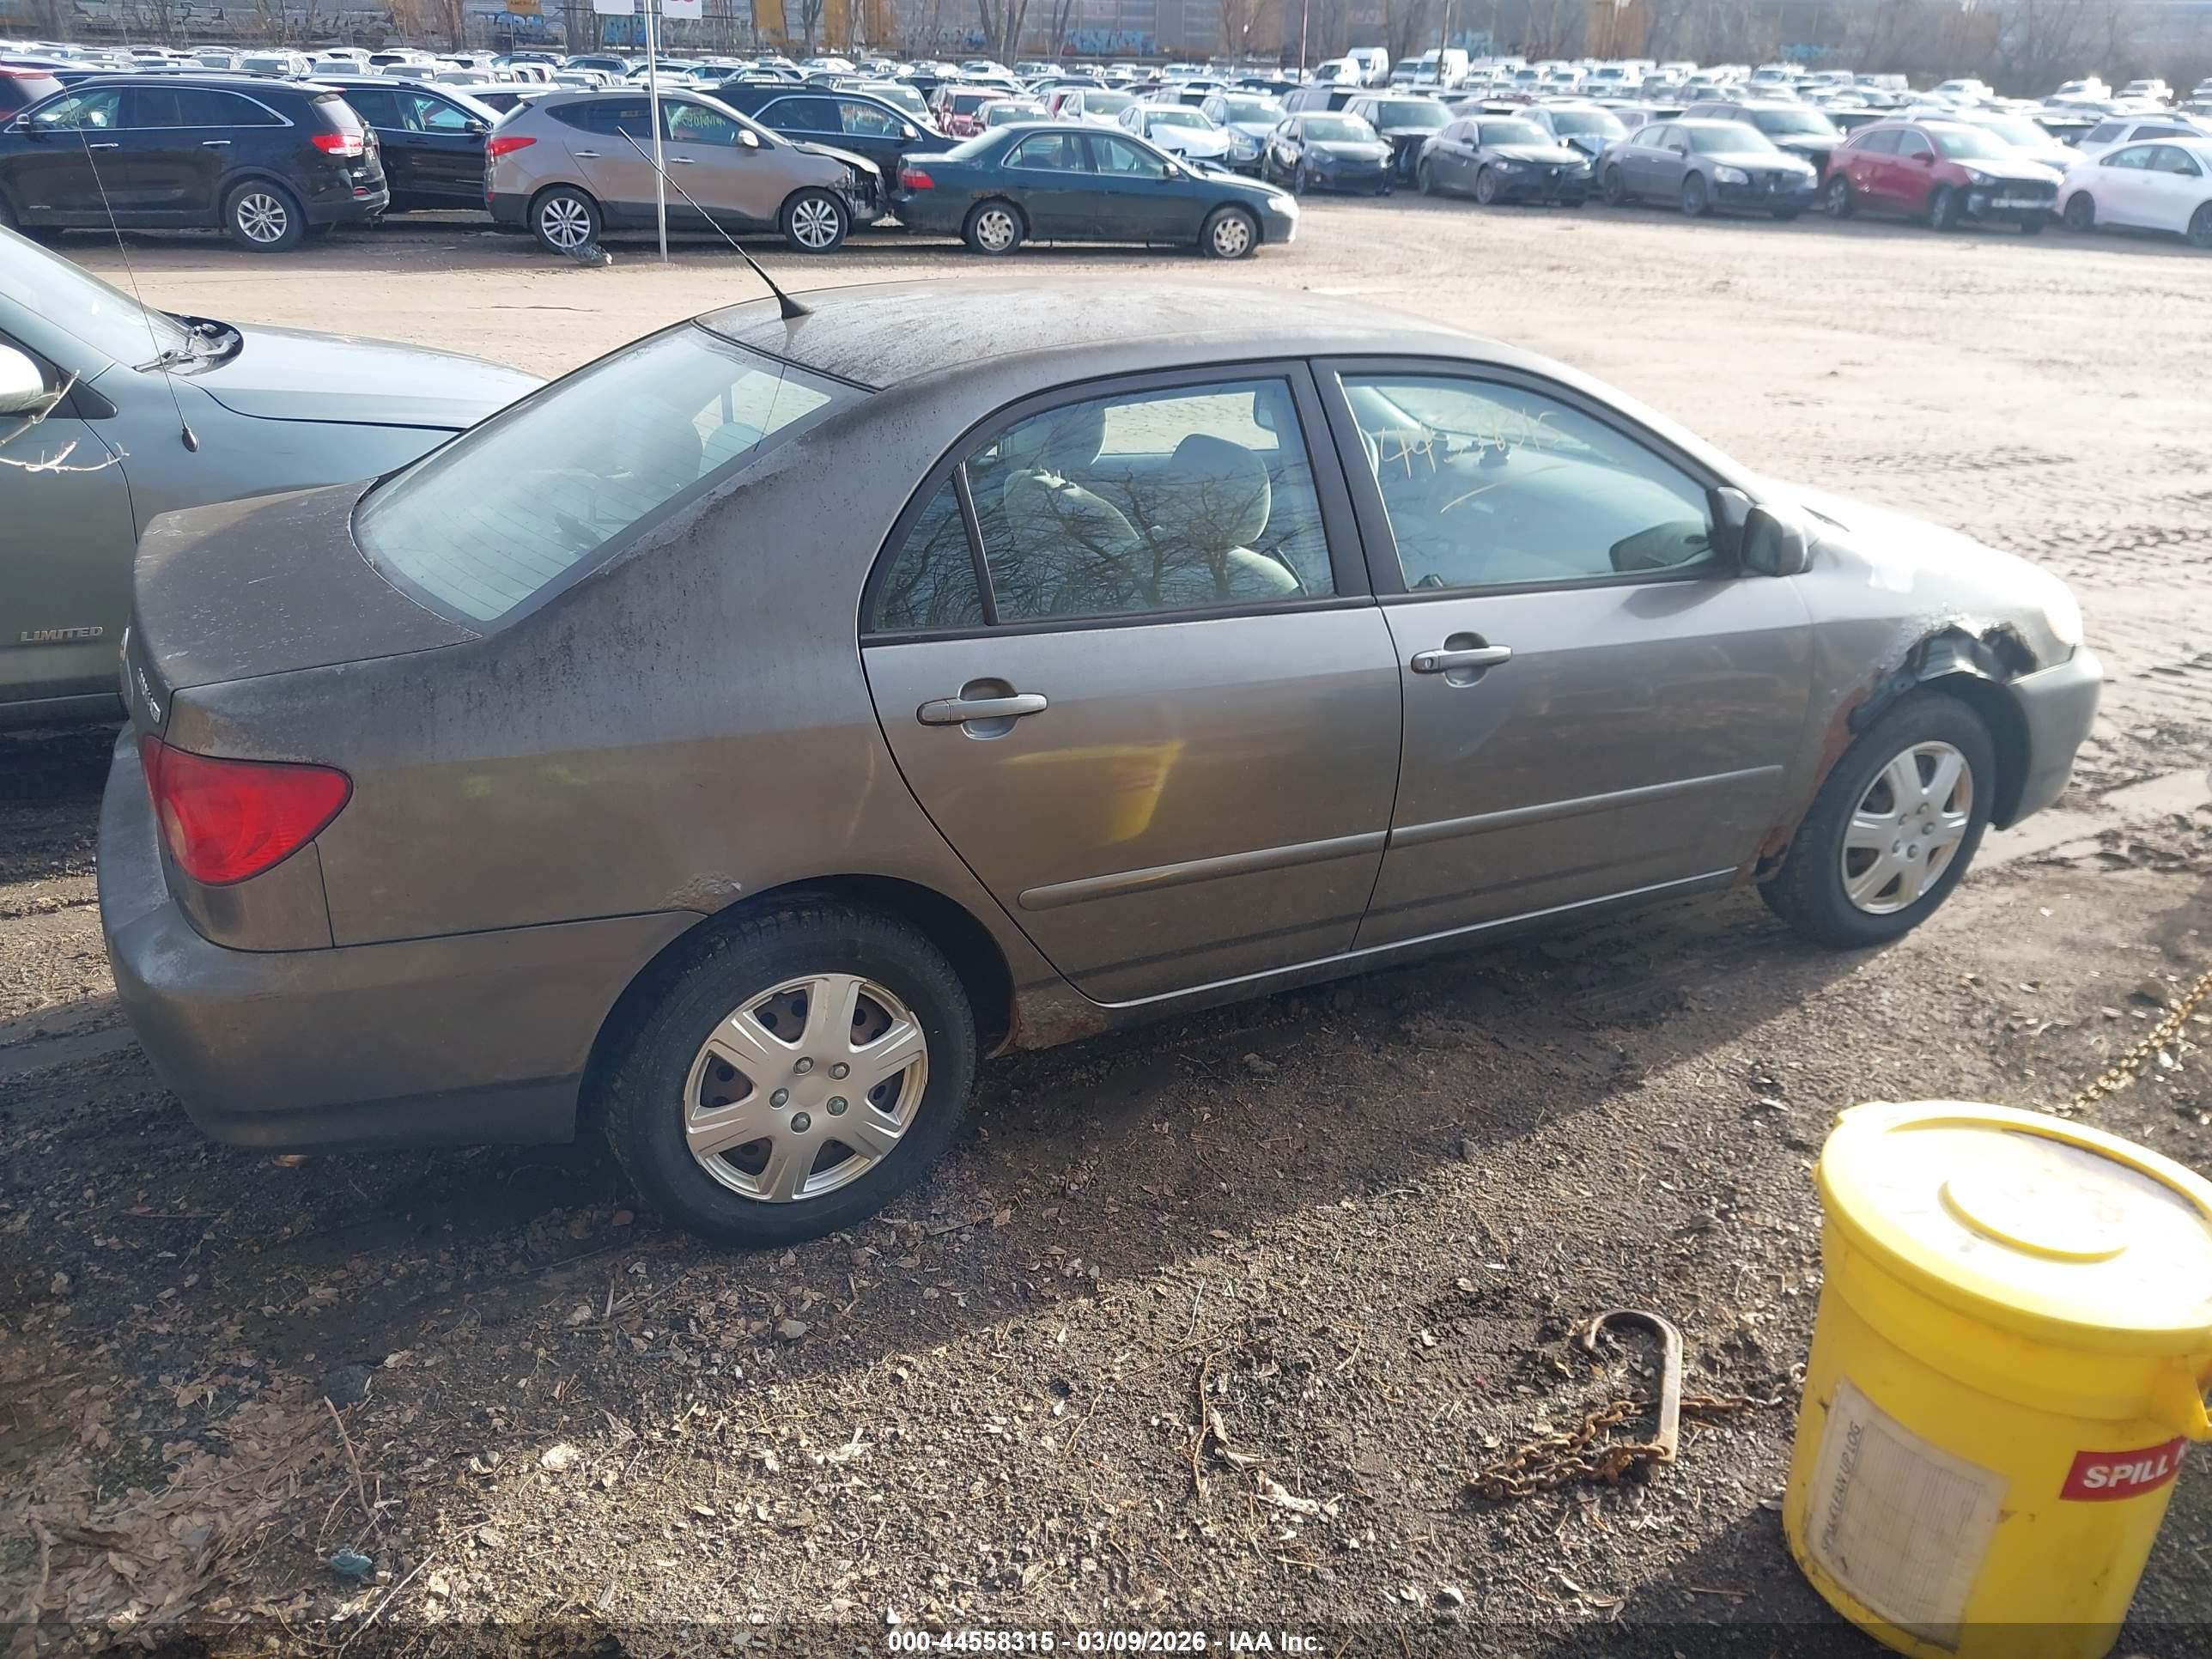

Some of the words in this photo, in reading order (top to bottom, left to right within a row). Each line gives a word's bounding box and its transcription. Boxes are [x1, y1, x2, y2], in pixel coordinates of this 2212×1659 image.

[21, 626, 103, 642] LIMITED
[1828, 1472, 1849, 1520] CLEAN
[1839, 1451, 1851, 1474] UP
[1845, 1420, 1861, 1454] LOG
[2083, 1455, 2168, 1489] SPILL
